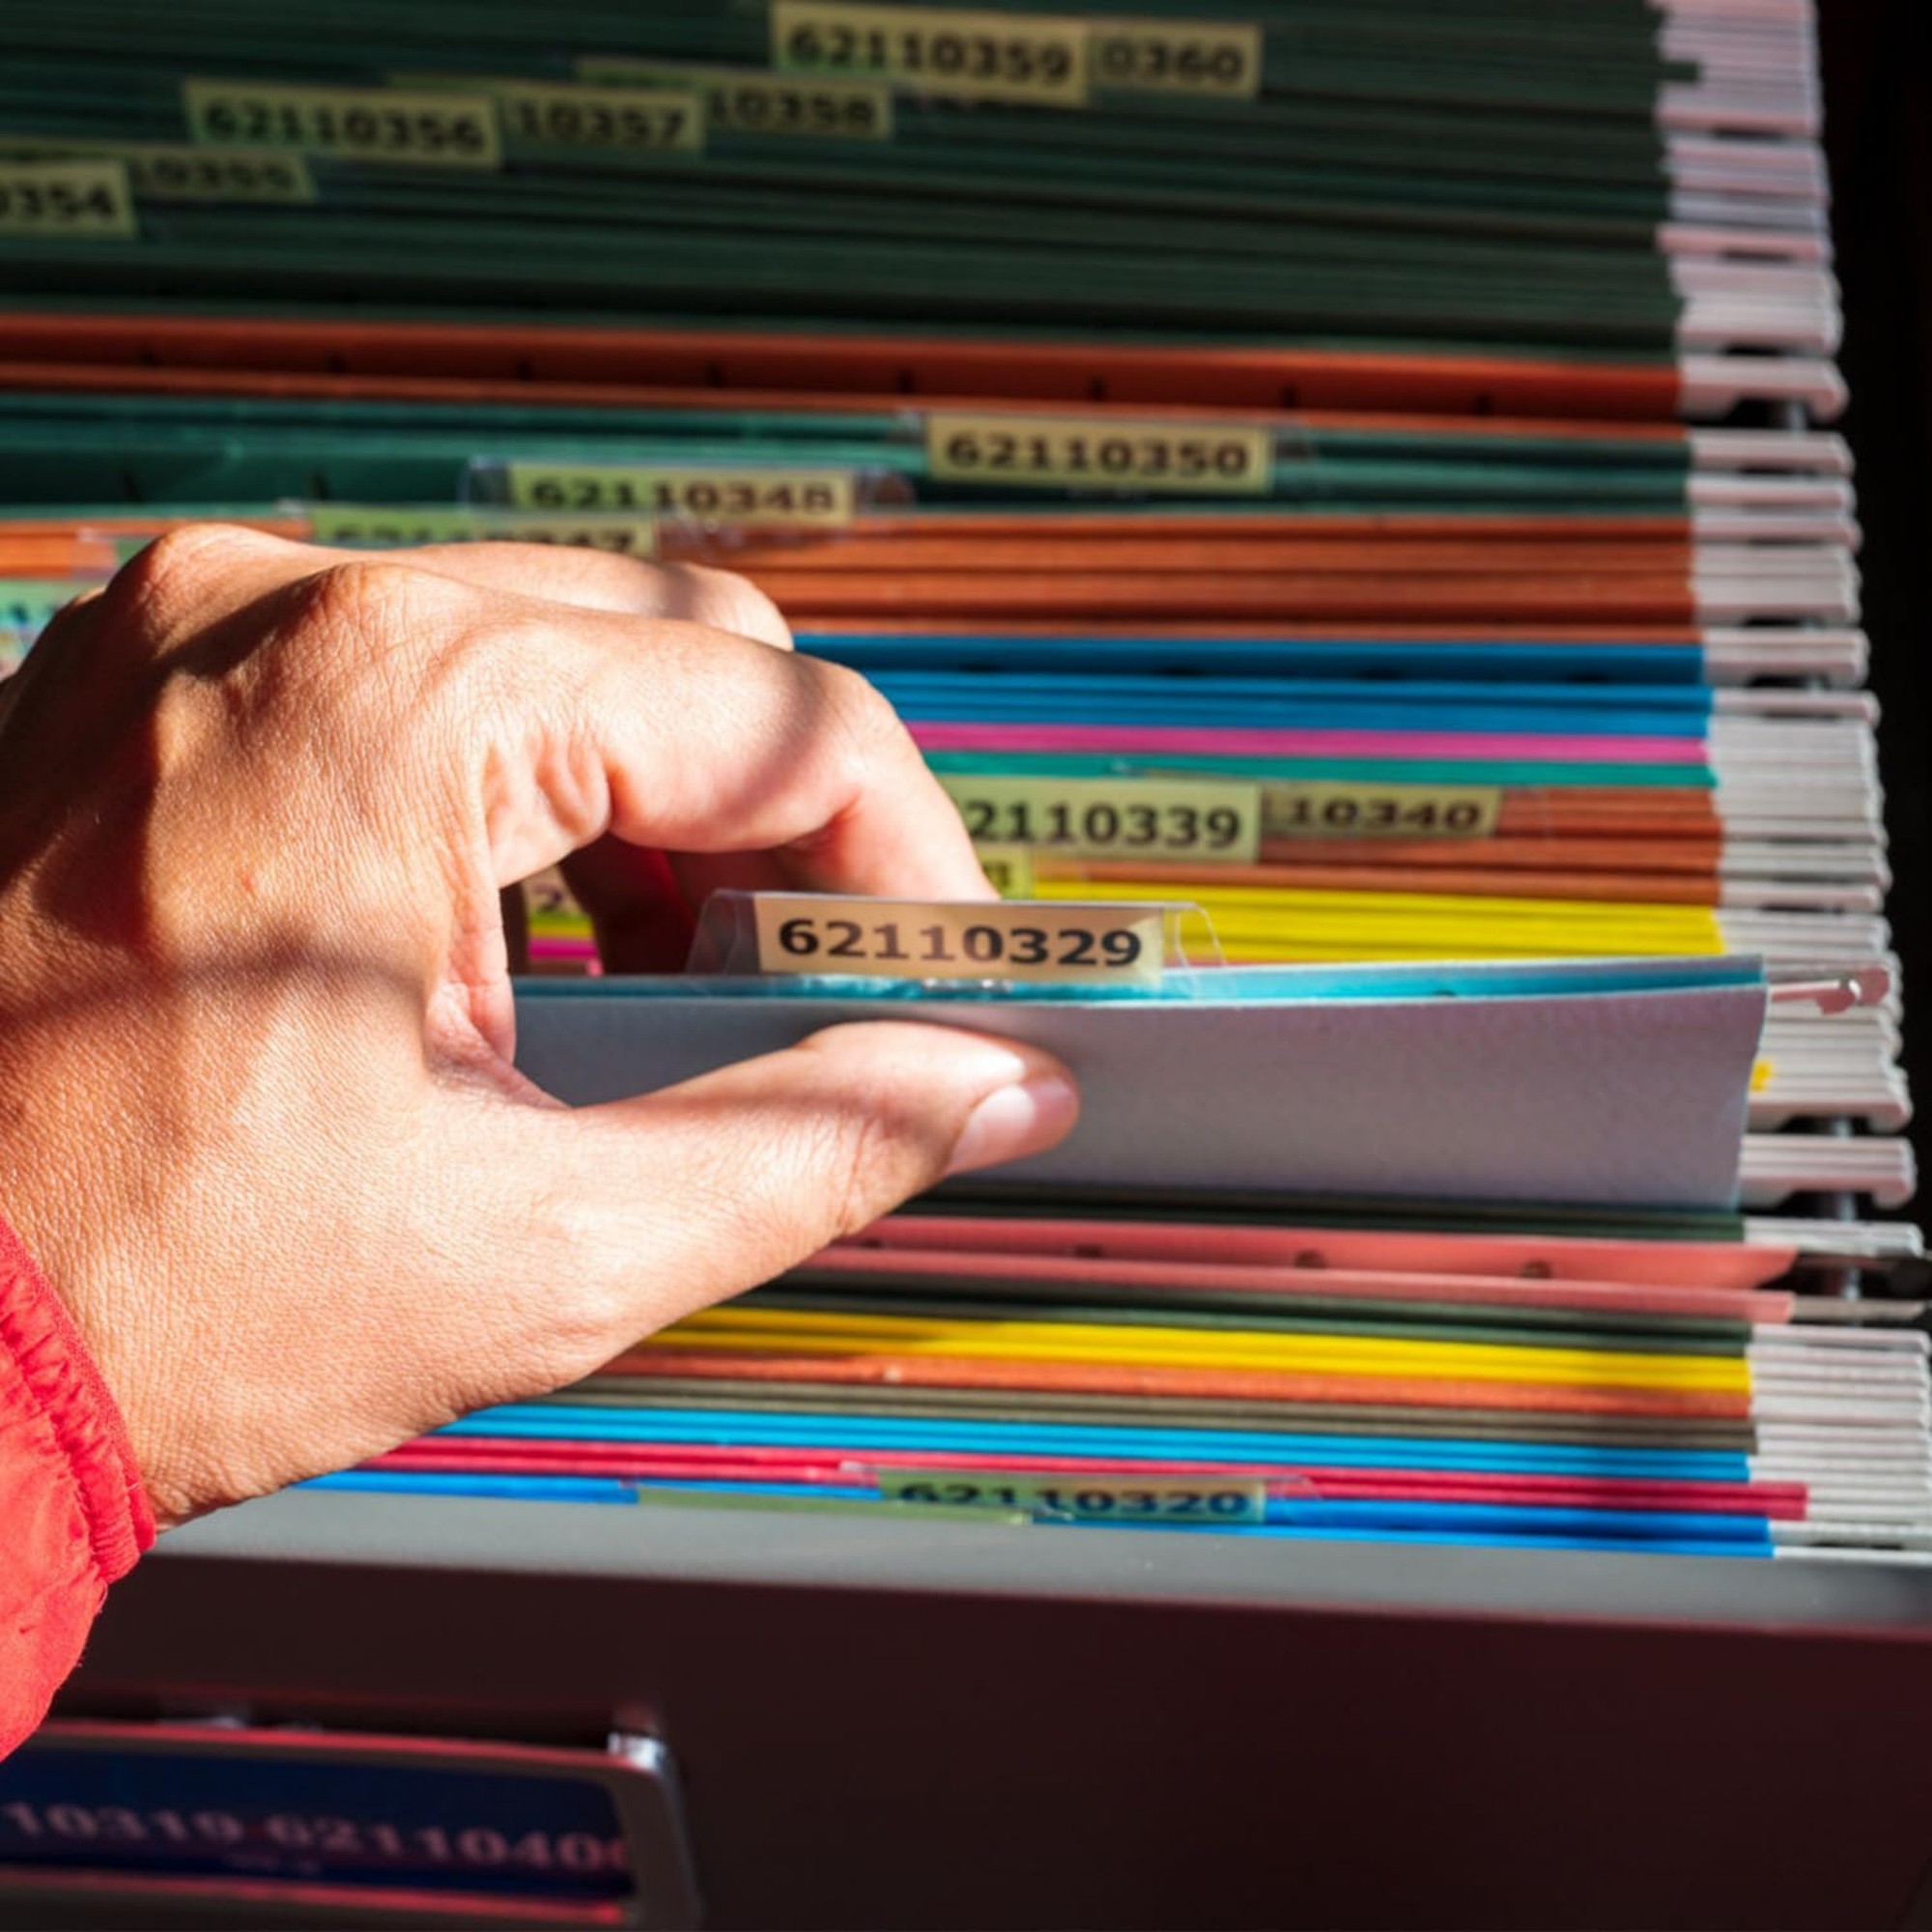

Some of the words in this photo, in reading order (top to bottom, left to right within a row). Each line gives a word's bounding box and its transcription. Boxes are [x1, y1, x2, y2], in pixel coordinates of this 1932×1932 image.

[788, 25, 1074, 84] 62110359
[205, 99, 484, 152] 62110356
[0, 183, 115, 216] 354
[946, 433, 1247, 479] 62110350
[531, 480, 833, 512] 62110348
[778, 918, 1142, 967] 62110329
[898, 1483, 1251, 1516] 62110320
